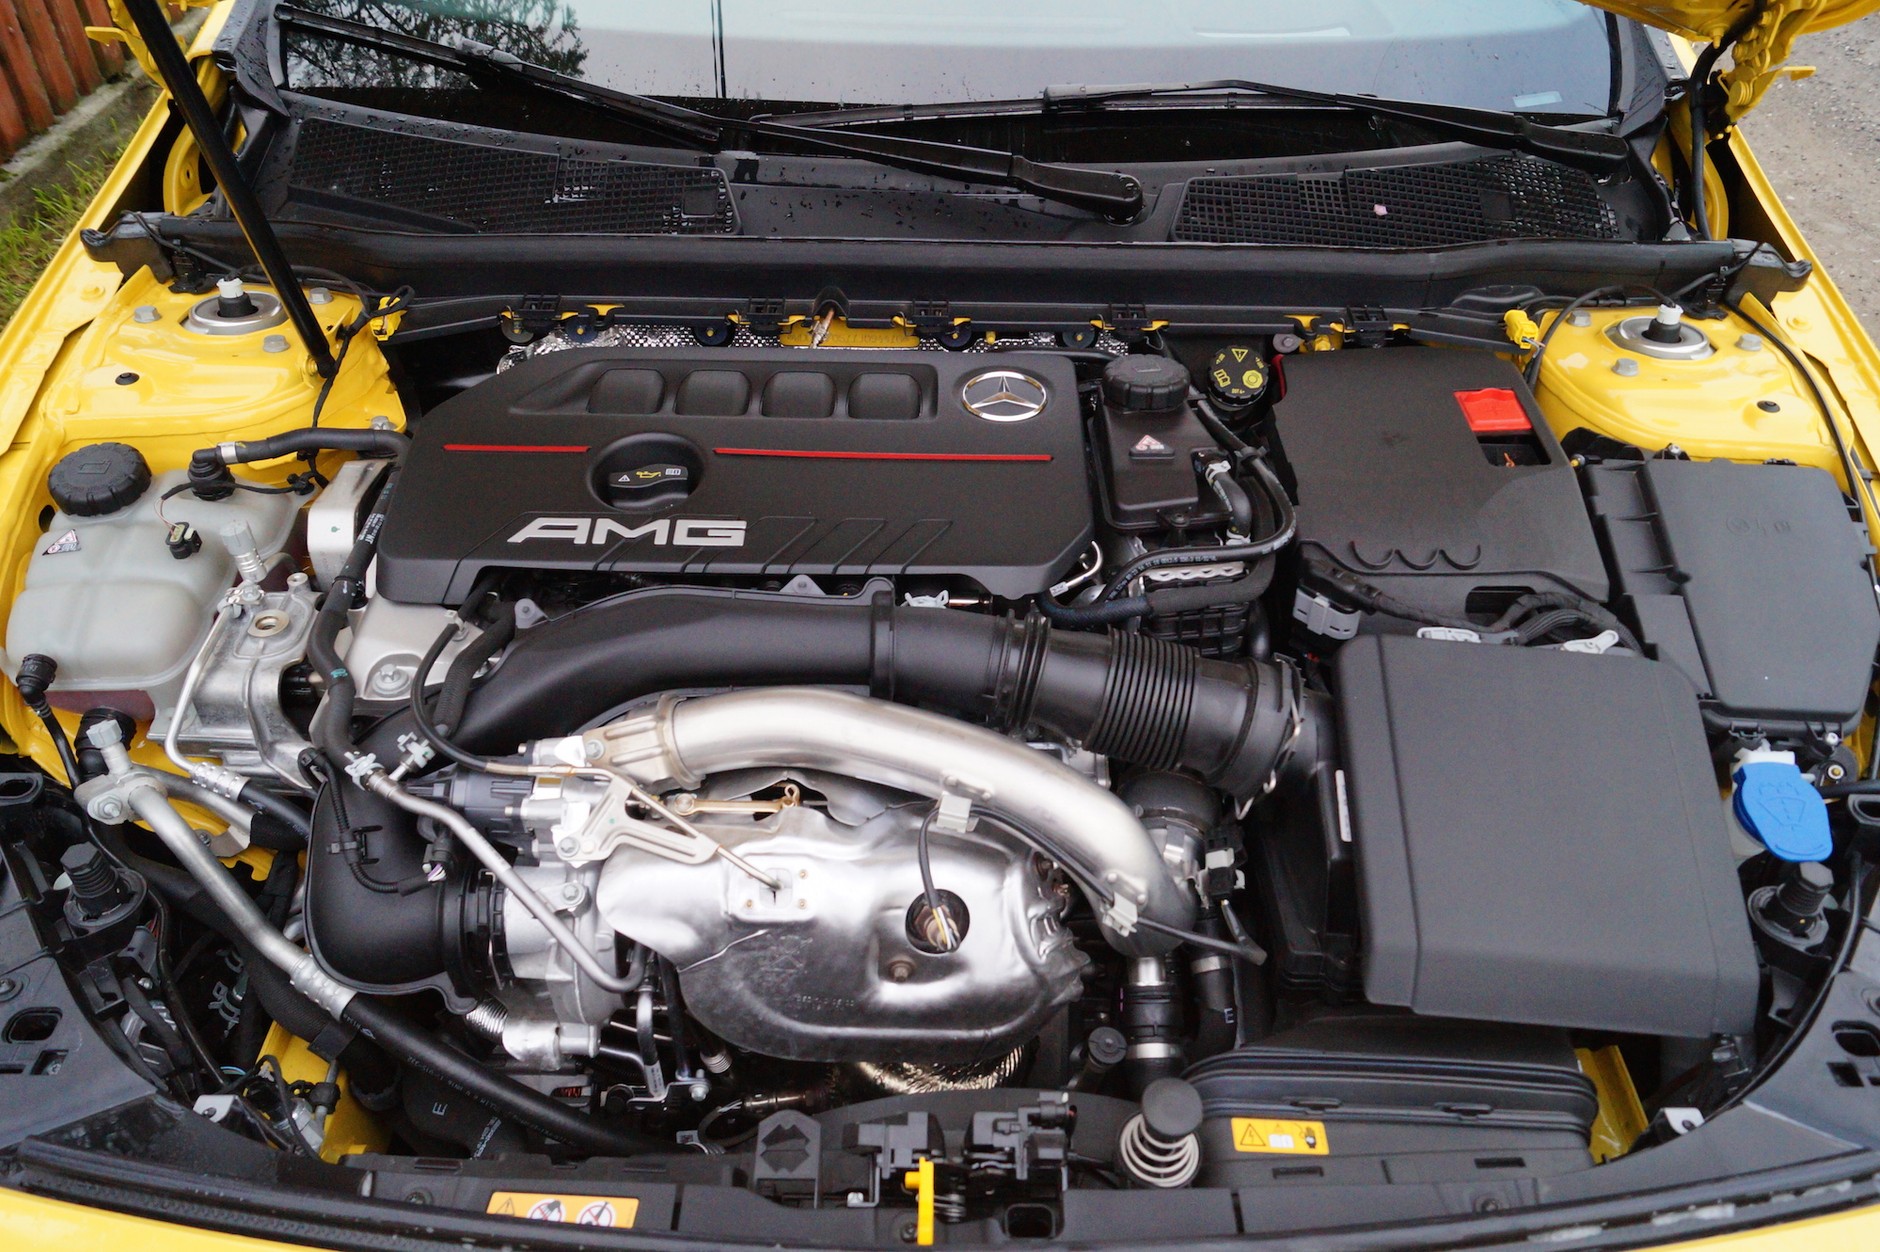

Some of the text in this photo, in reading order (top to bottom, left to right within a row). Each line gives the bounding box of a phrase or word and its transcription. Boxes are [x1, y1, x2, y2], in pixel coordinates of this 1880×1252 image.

[507, 517, 747, 546] AMG
[1224, 1007, 1235, 1024] E
[432, 1102, 448, 1116] E
